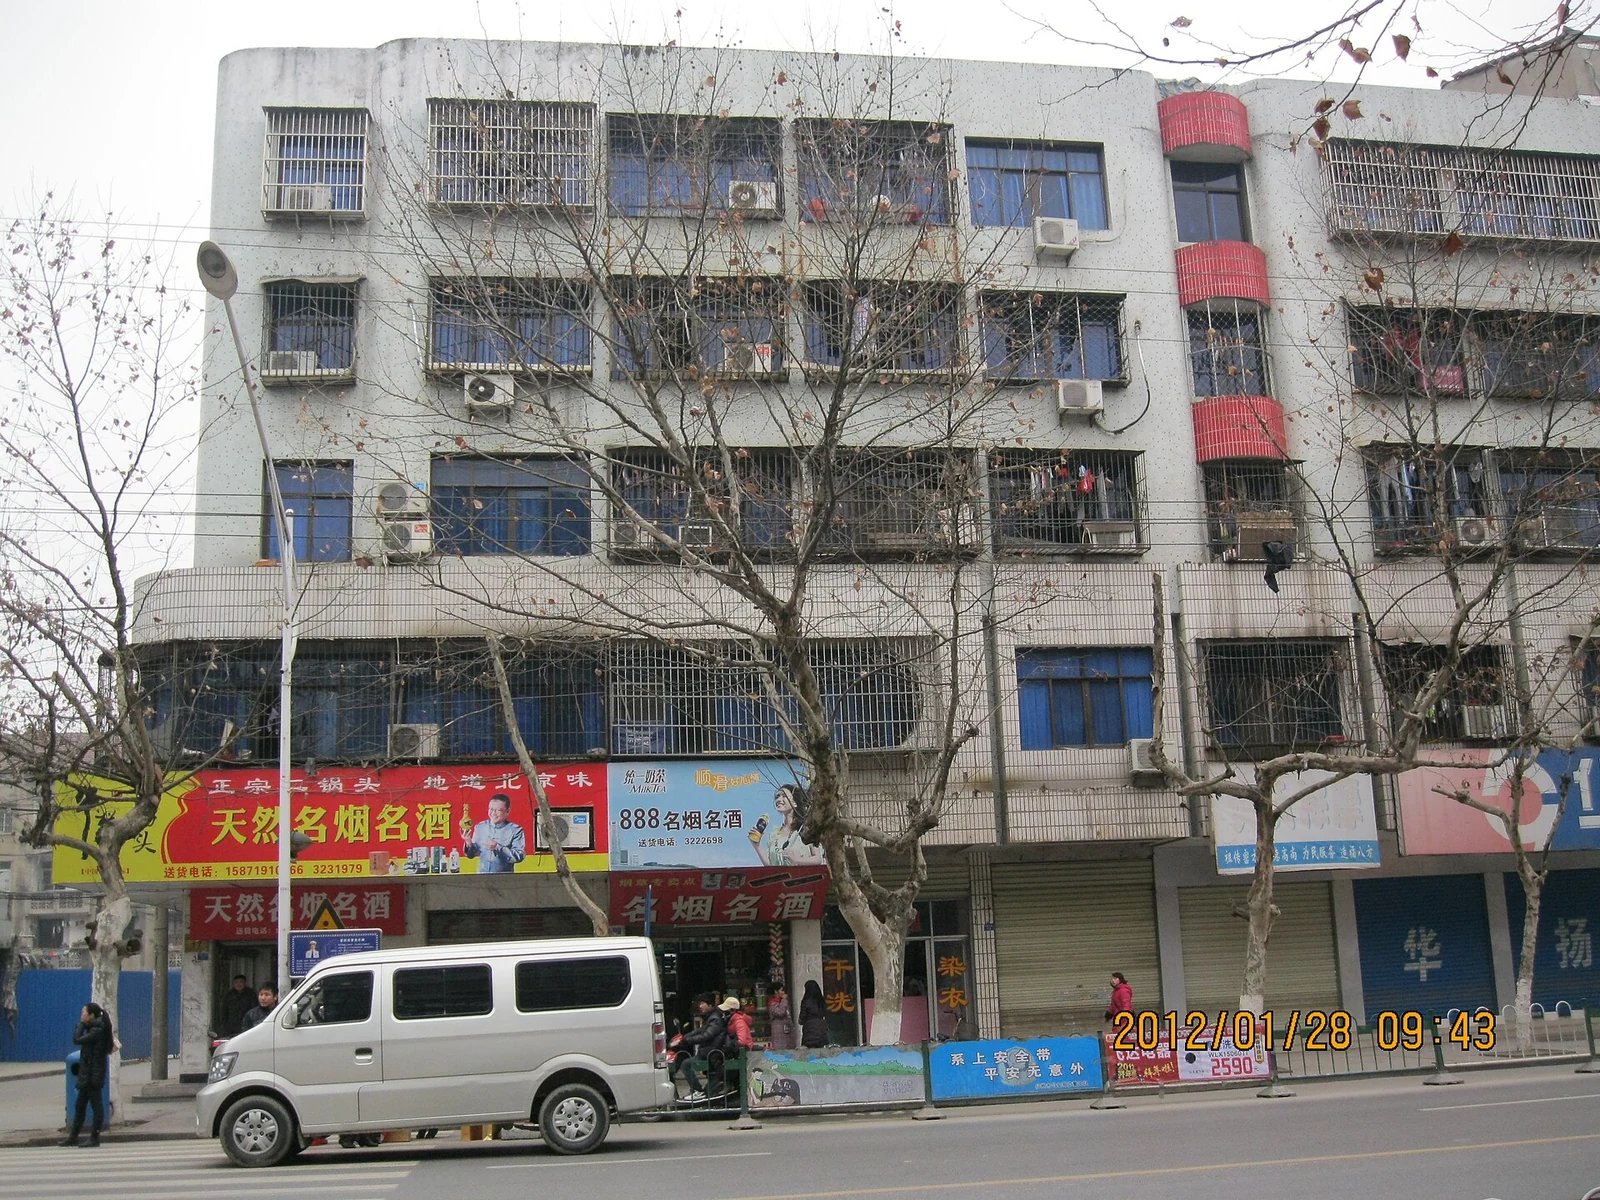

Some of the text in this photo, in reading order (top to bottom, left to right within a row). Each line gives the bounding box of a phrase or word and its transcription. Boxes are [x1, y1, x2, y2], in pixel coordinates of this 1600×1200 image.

[423, 771, 593, 791] 地道北京味
[623, 769, 667, 785] 统一奶茶
[211, 802, 452, 846] 天然名烟名酒
[620, 808, 742, 831] 888名烟名酒
[685, 837, 723, 845] 3222698
[1302, 845, 1336, 860] 为民服务
[164, 866, 218, 878] 送货电话：
[313, 863, 363, 874] 3231979
[621, 891, 815, 923] 名烟名酒
[1554, 917, 1592, 969] 扬
[1403, 927, 1442, 982] 华
[824, 959, 855, 1013] 干洗
[938, 956, 969, 1009] 染衣
[950, 1048, 1051, 1066] 系上安全带
[1211, 1056, 1253, 1076] 2590
[984, 1062, 1084, 1081] 平安无意外
